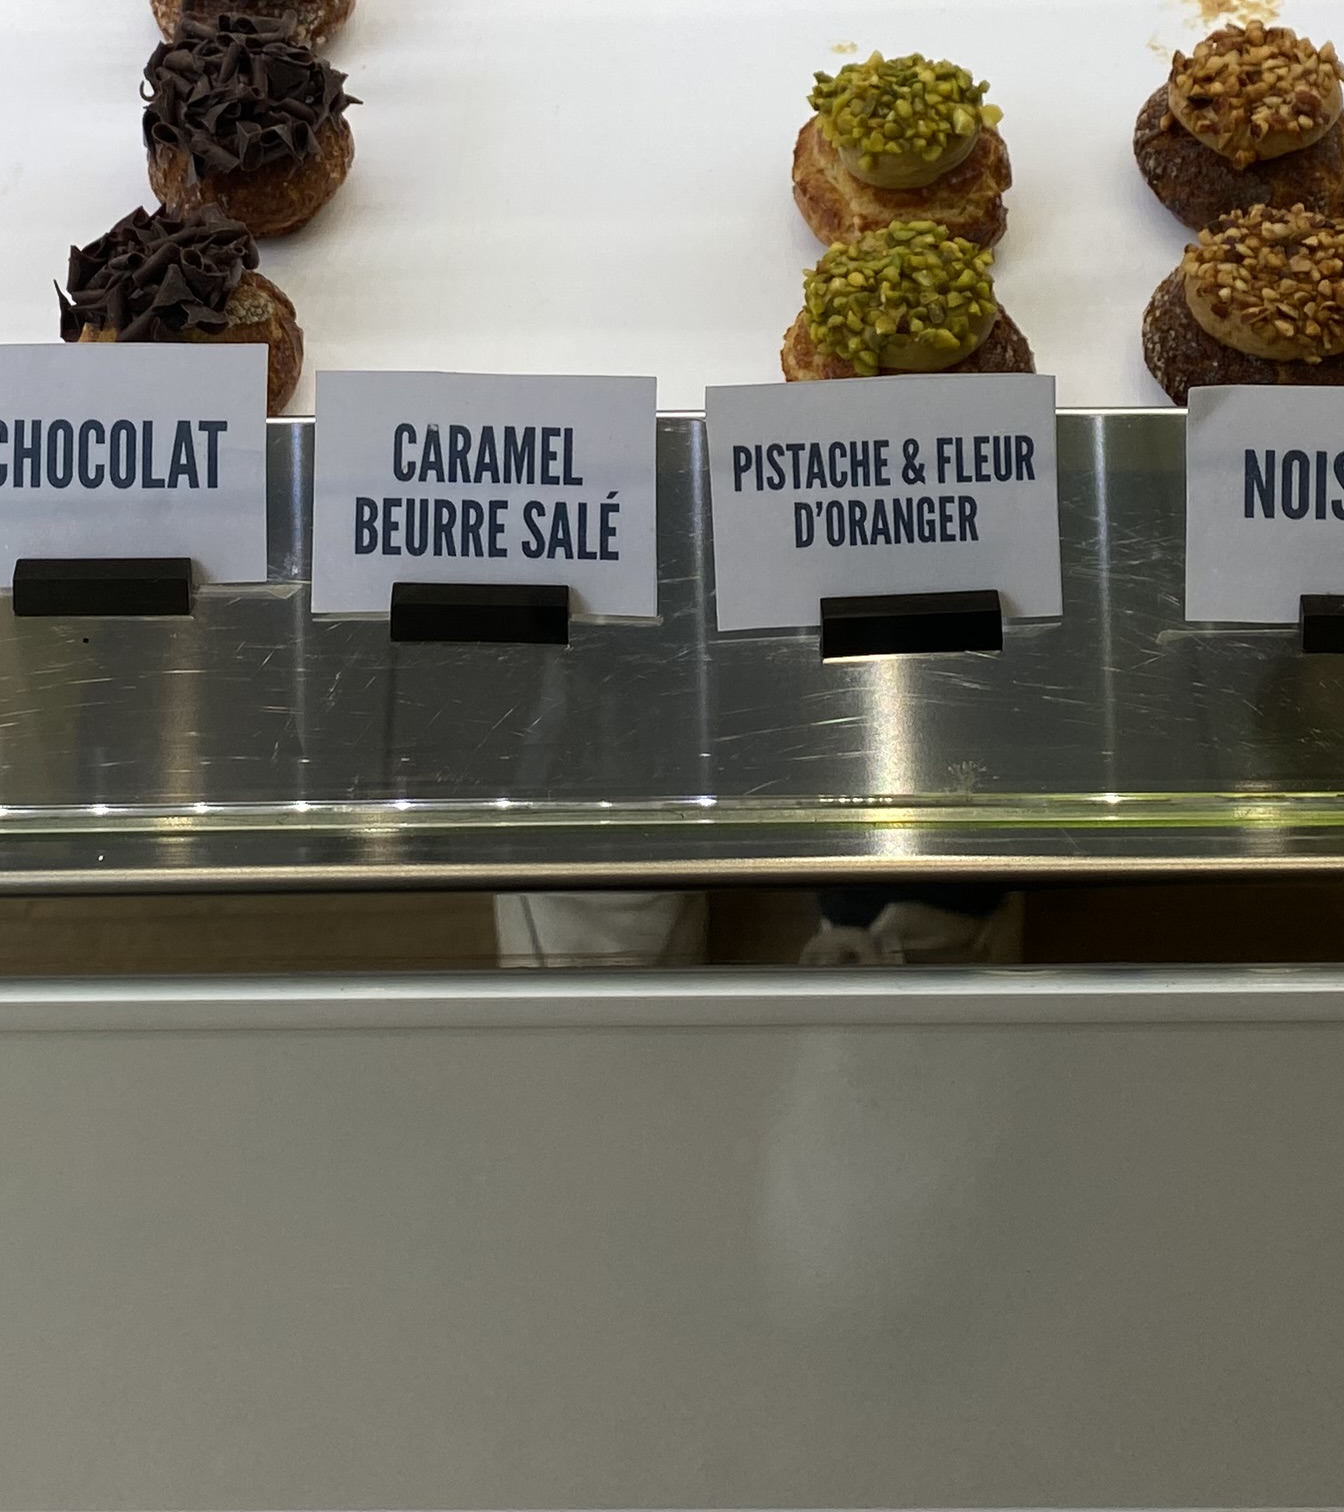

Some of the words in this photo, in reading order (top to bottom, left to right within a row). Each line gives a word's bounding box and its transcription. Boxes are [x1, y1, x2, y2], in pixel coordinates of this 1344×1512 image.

[392, 422, 585, 487] CARAMEL
[731, 437, 892, 494] PISTACHE
[900, 436, 928, 487] &
[935, 433, 1037, 485] FLEUR
[354, 495, 510, 559] BEURRE
[521, 489, 621, 562] SALÉ
[792, 494, 981, 550] D'ORANGER
